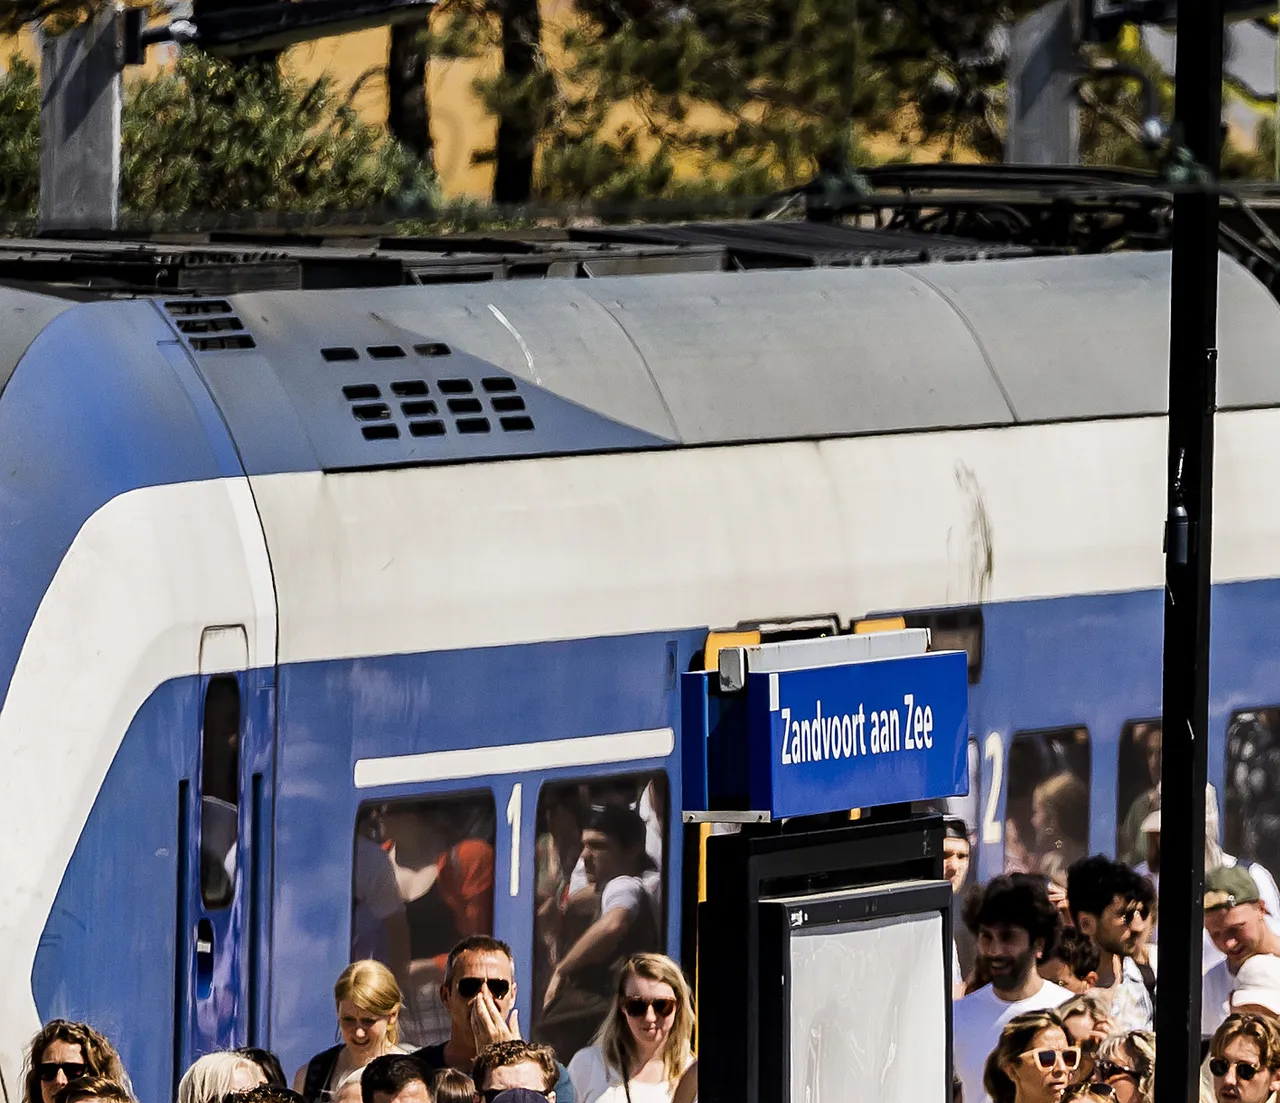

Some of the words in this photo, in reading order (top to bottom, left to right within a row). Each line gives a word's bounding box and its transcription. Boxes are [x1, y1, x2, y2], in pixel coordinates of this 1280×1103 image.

[781, 699, 867, 765] Zandvoort
[870, 708, 900, 755] aan
[903, 693, 934, 751] Zee
[506, 782, 522, 897] 1
[982, 731, 1003, 844] 2
